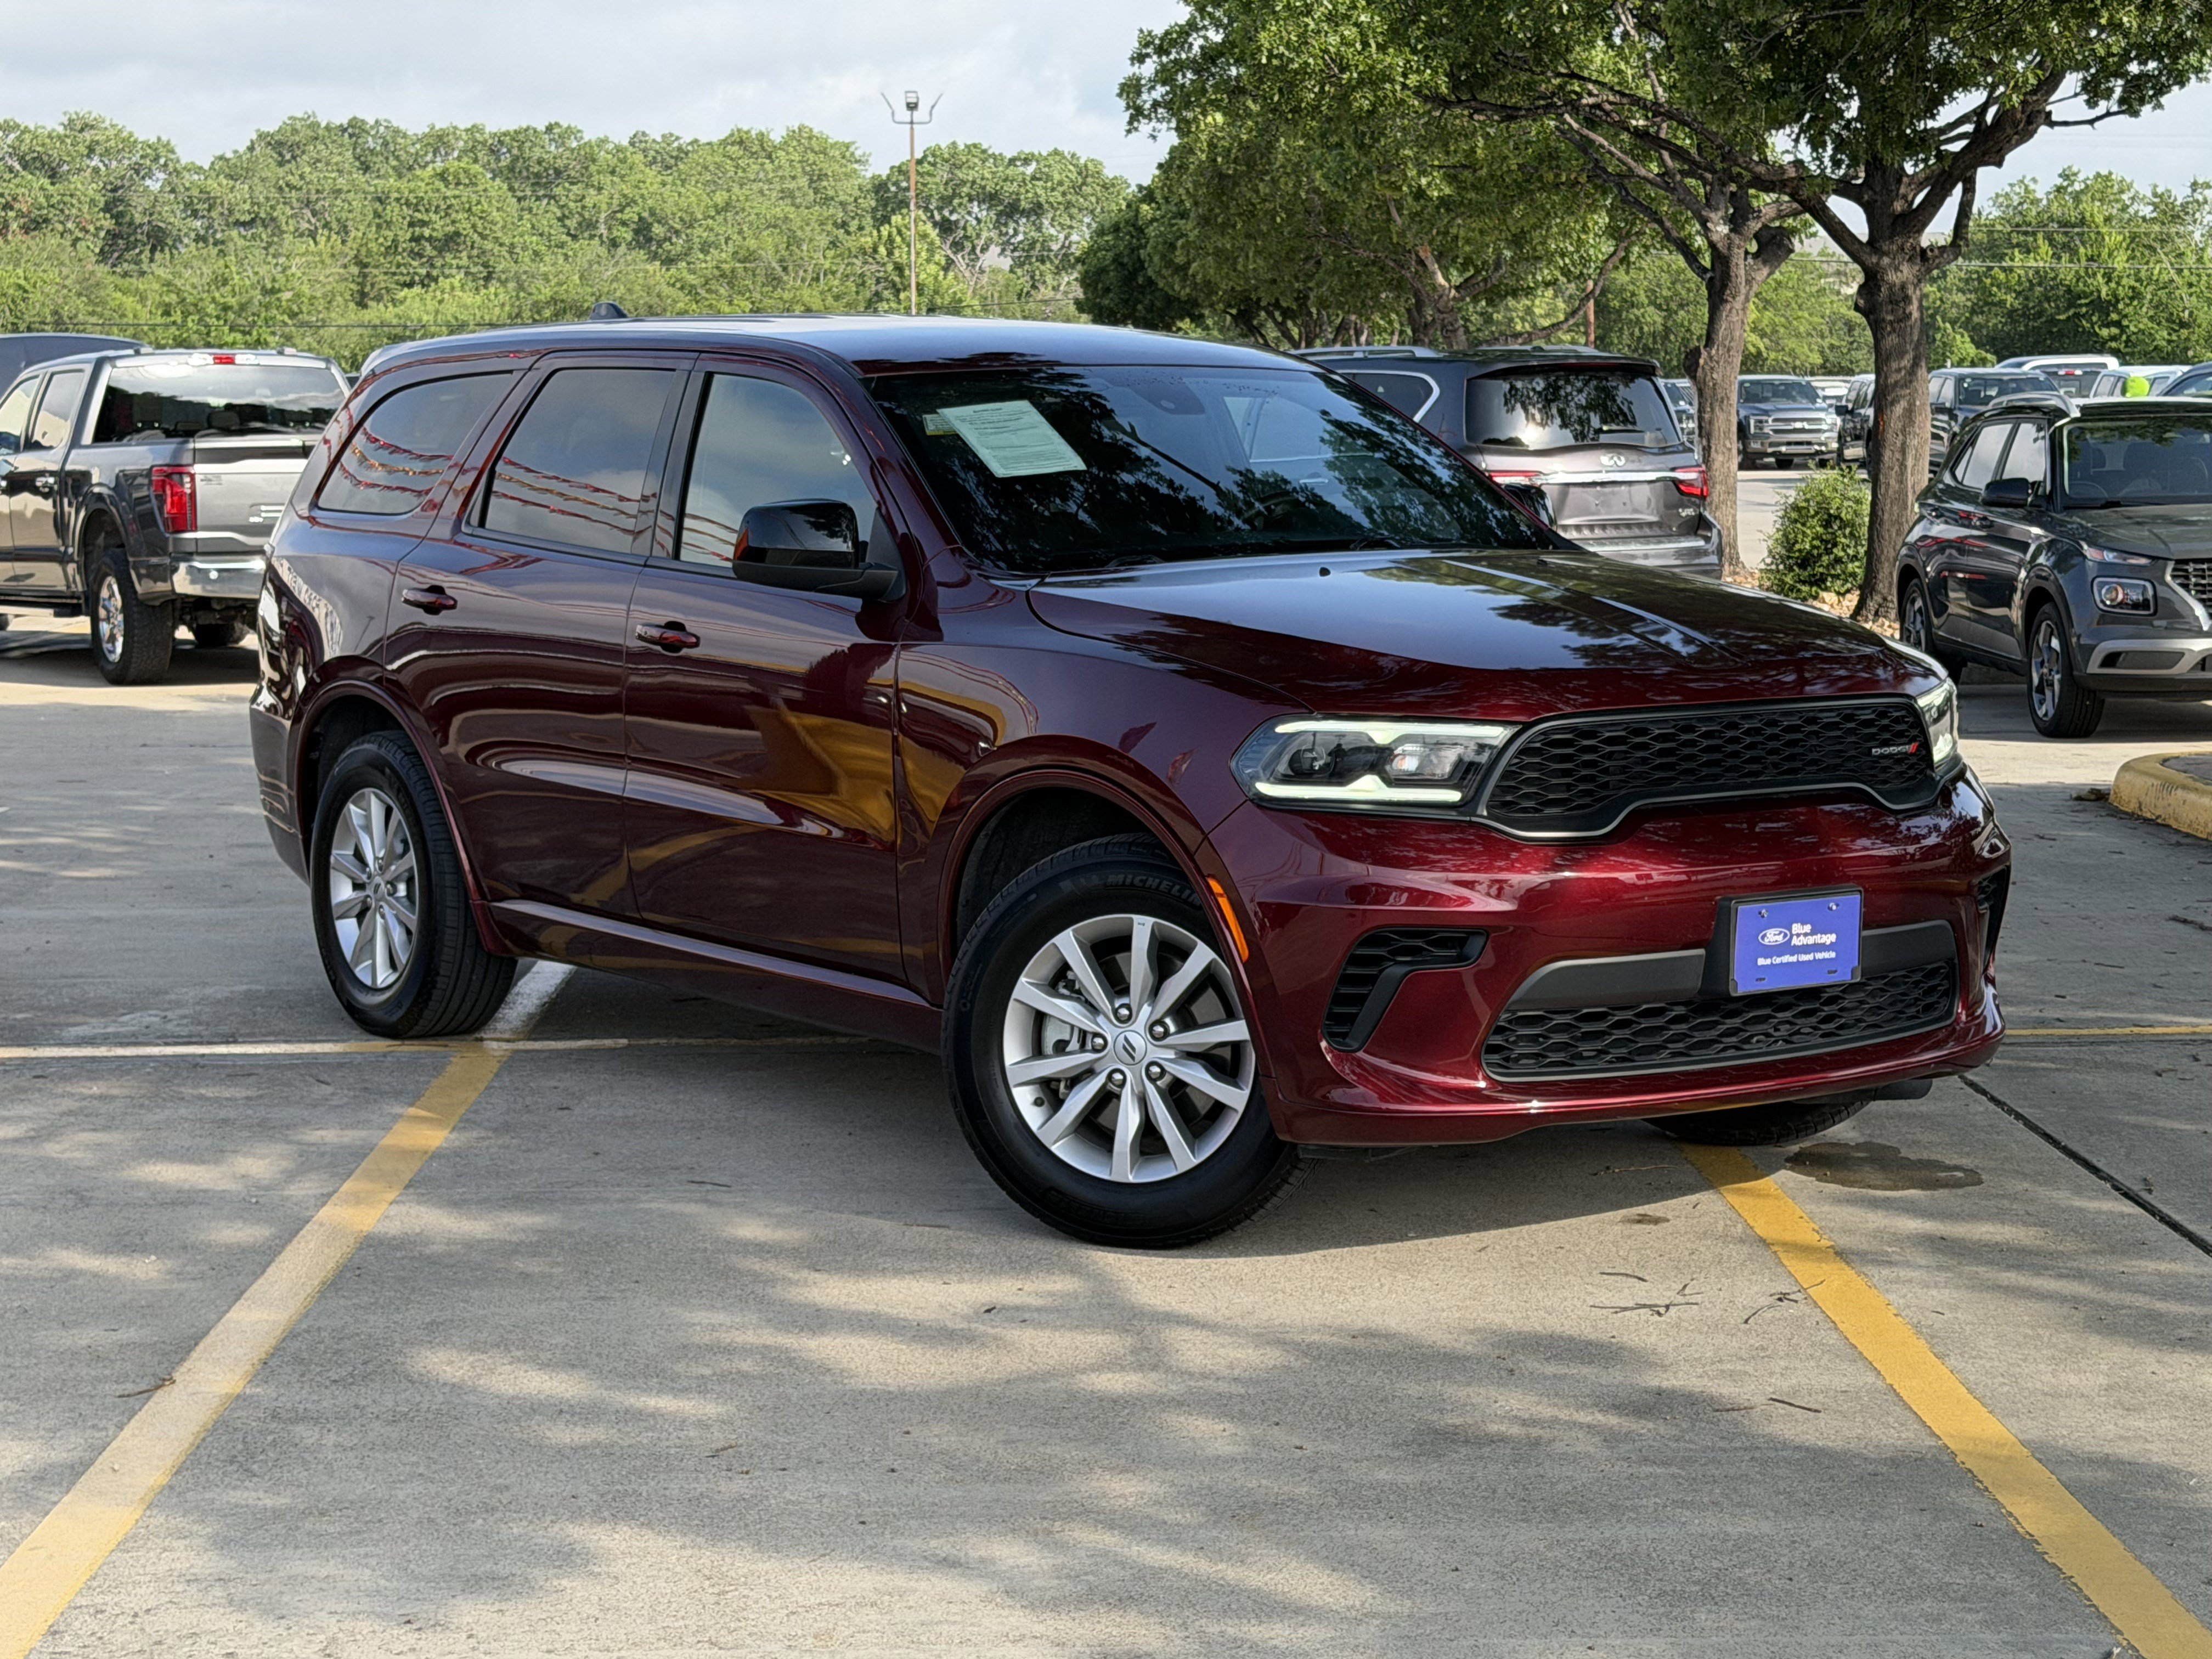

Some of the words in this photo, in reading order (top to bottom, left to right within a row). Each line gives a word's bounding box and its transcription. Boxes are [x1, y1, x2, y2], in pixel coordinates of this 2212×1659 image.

[1792, 923, 1812, 934] Blue
[1764, 930, 1784, 943] Ford
[1791, 933, 1836, 946] Advantage
[1757, 957, 1771, 966] Blue
[1772, 954, 1797, 964] Certified
[1798, 952, 1814, 961] Used
[1814, 950, 1836, 960] Vehicle
